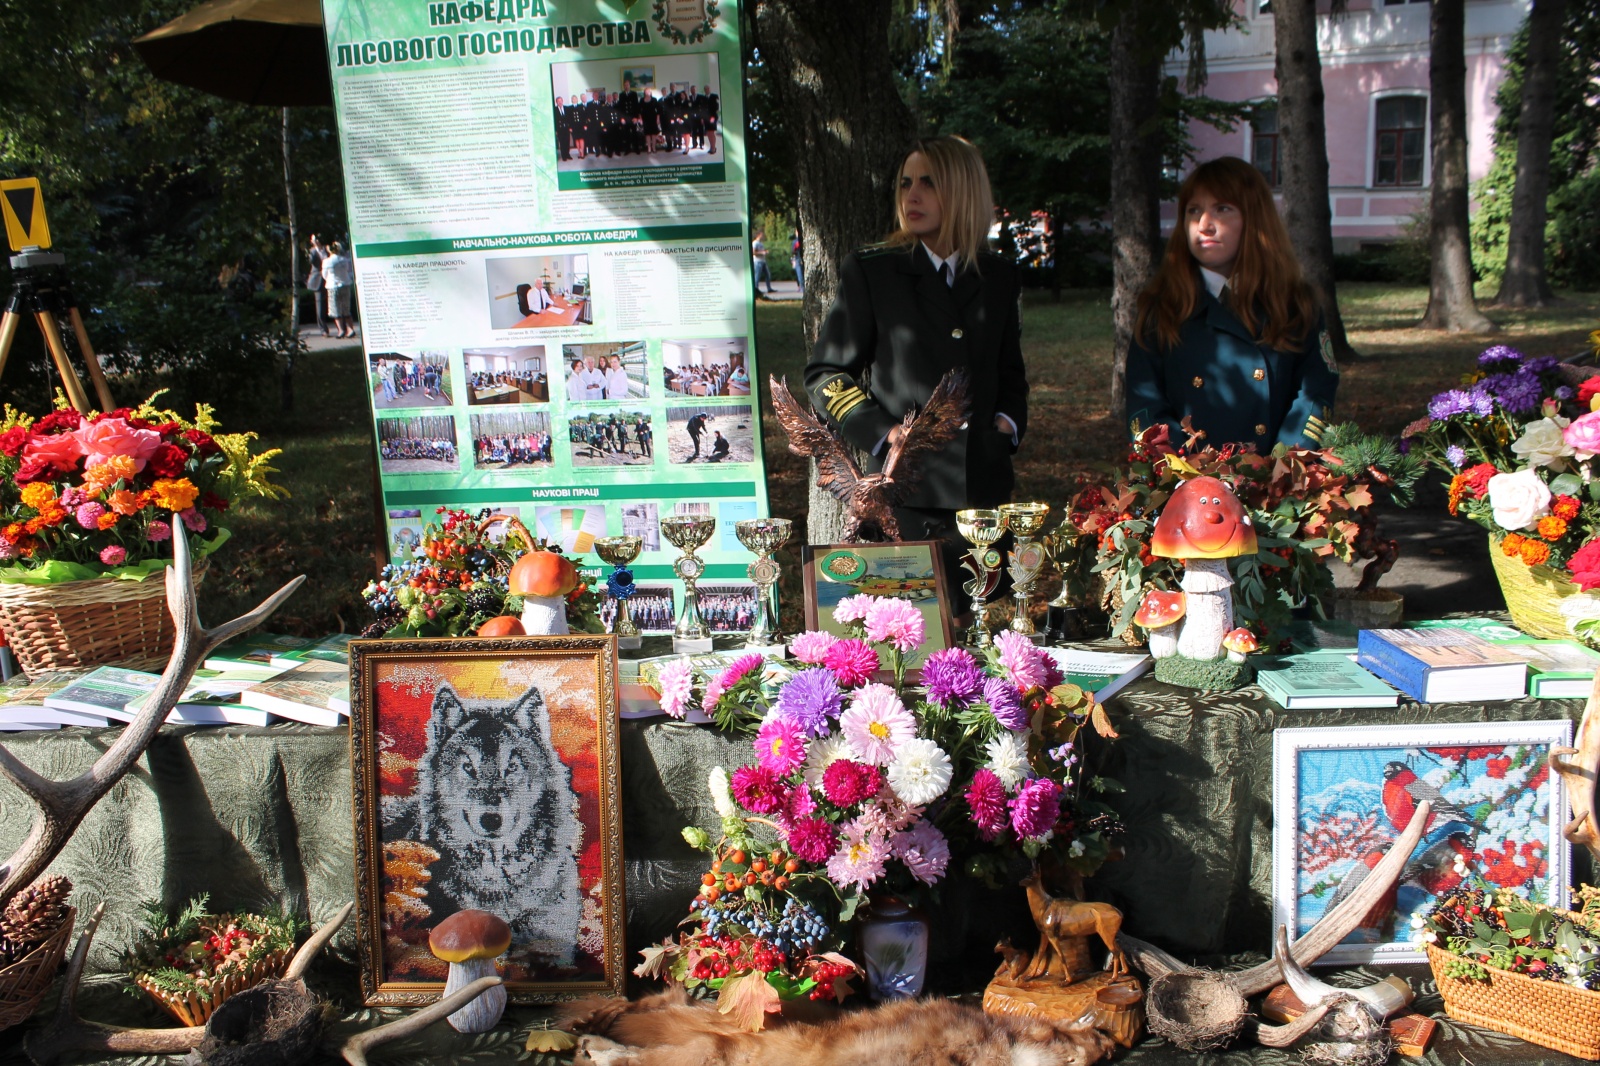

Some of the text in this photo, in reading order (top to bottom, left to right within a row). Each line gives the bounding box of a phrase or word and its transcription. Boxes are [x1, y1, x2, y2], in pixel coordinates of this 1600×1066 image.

[430, 0, 547, 26] КАФЕДРА
[337, 21, 650, 66] ЛІСОВОГО ГОСПОДАРСТВА
[453, 230, 638, 249] НАВЧАЛЬНО-НАУКОВА РОБОТА КАФЕДРИ
[644, 247, 695, 255] ВИКЛАДАЄТЬСЯ
[532, 488, 600, 498] НАУКОВІ ПРАЦІ
